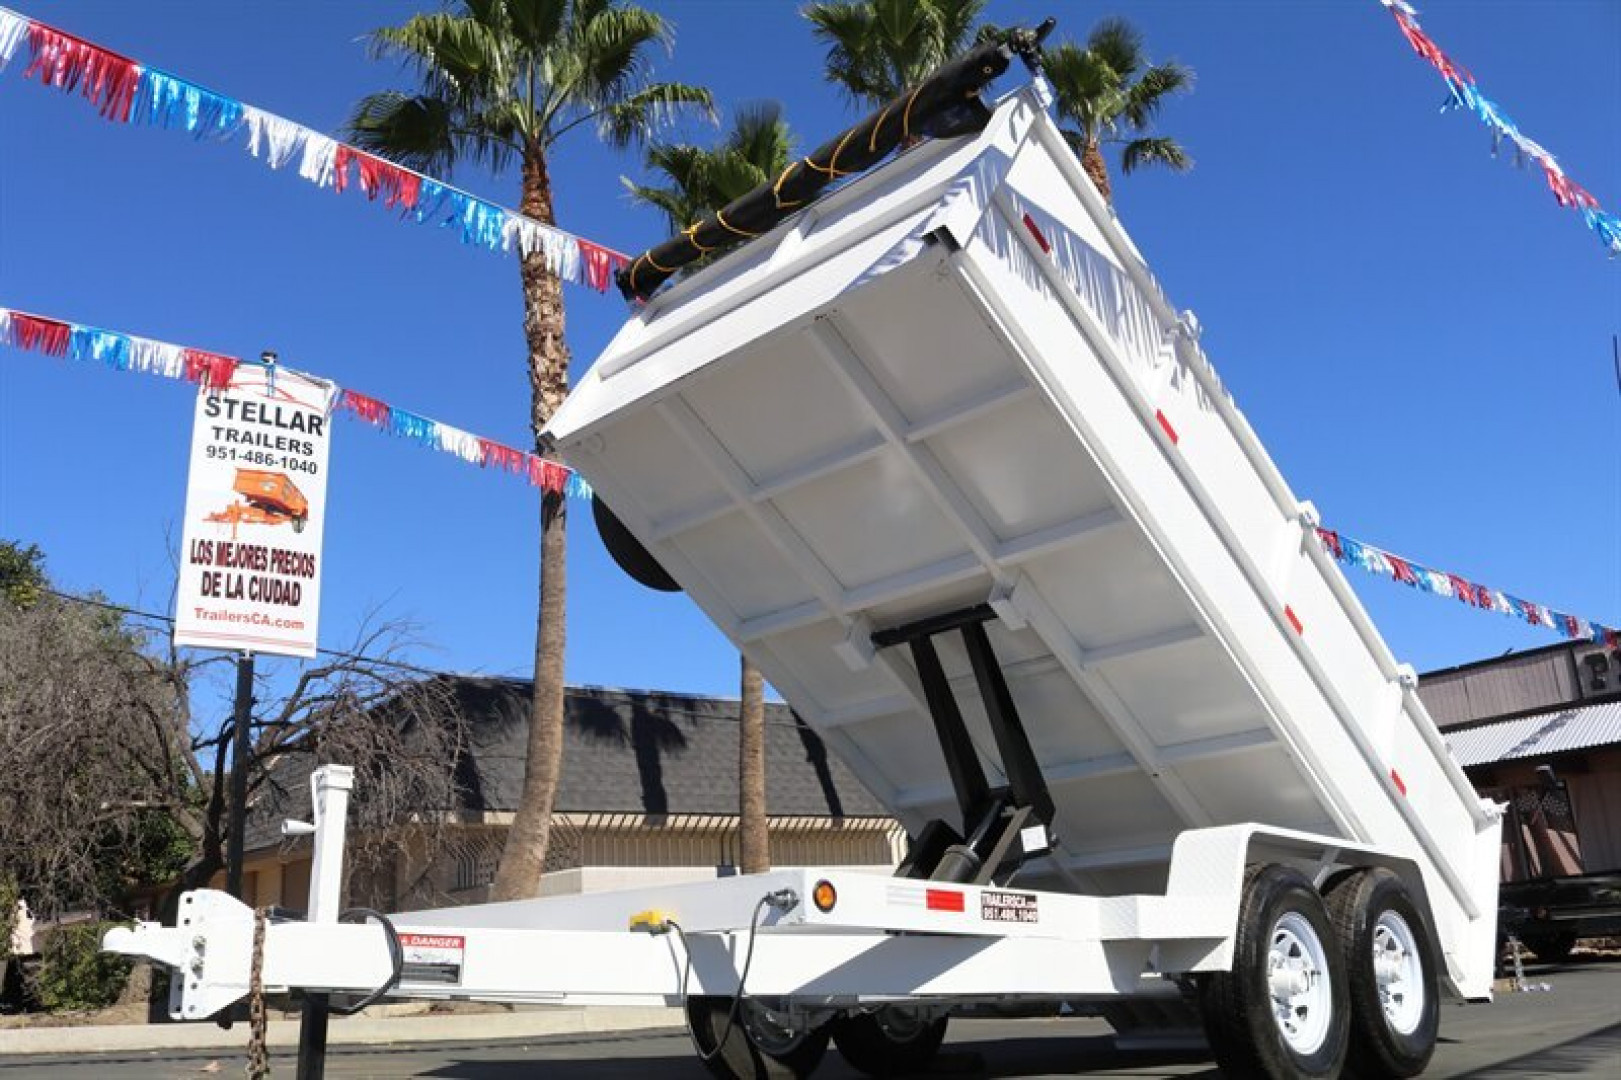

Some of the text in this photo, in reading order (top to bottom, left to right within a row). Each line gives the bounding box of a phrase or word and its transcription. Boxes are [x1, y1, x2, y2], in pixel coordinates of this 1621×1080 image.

[205, 396, 322, 436] STELLAR
[212, 425, 313, 456] TRAILERS
[206, 445, 317, 475] 951-486-1040
[190, 538, 314, 579] LOS MEJORES PRECIOS
[201, 571, 302, 607] DE LA CIUDAD
[194, 607, 304, 630] TrailersCA.com
[411, 936, 459, 947] DANGER
